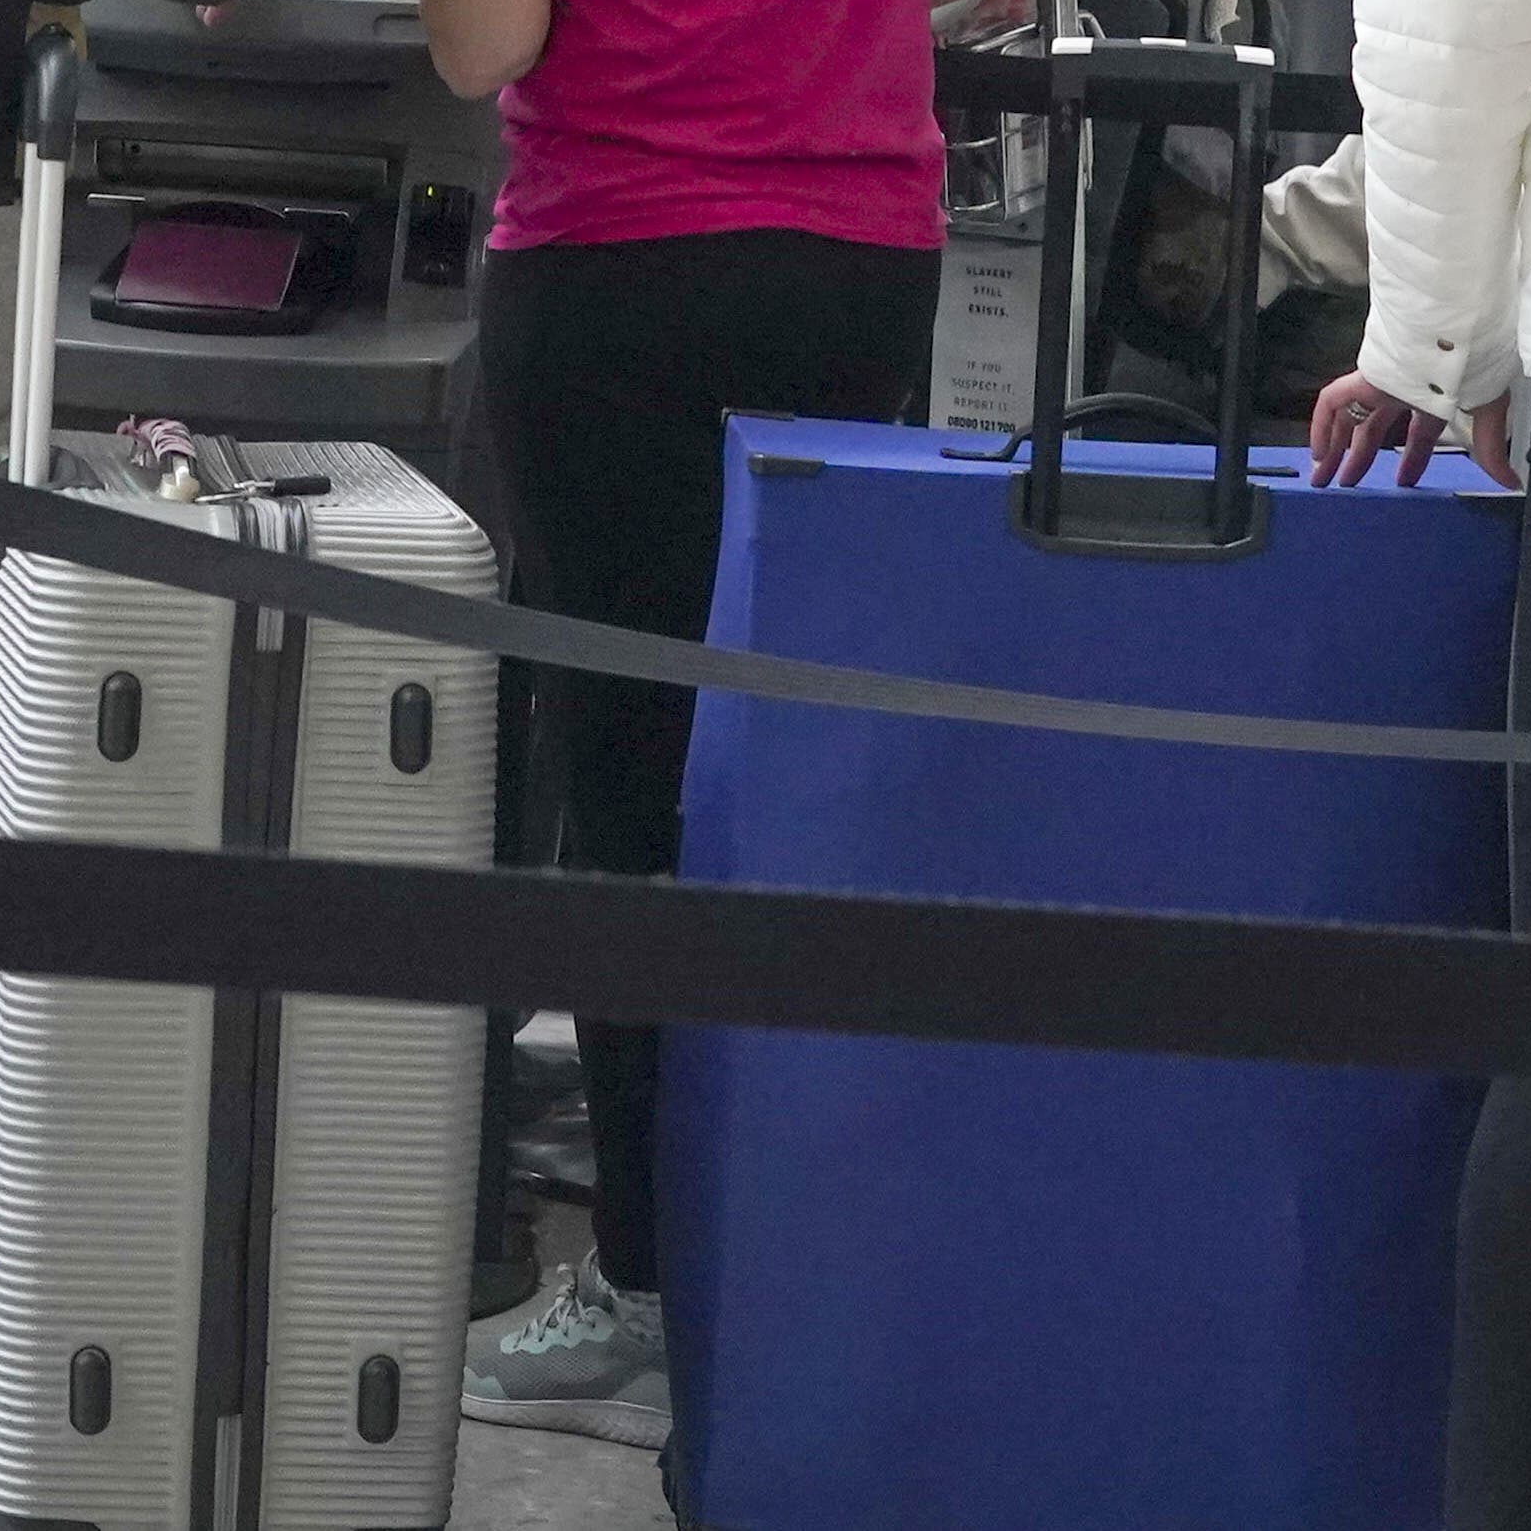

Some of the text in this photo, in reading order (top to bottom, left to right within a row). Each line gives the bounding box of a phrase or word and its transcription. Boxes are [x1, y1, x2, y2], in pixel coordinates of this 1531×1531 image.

[965, 266, 1013, 280] SLAVERY
[973, 285, 1003, 298] STILL
[967, 360, 1003, 375] IF YOU
[951, 377, 998, 392] SUSPECT
[953, 396, 995, 411] REPORT
